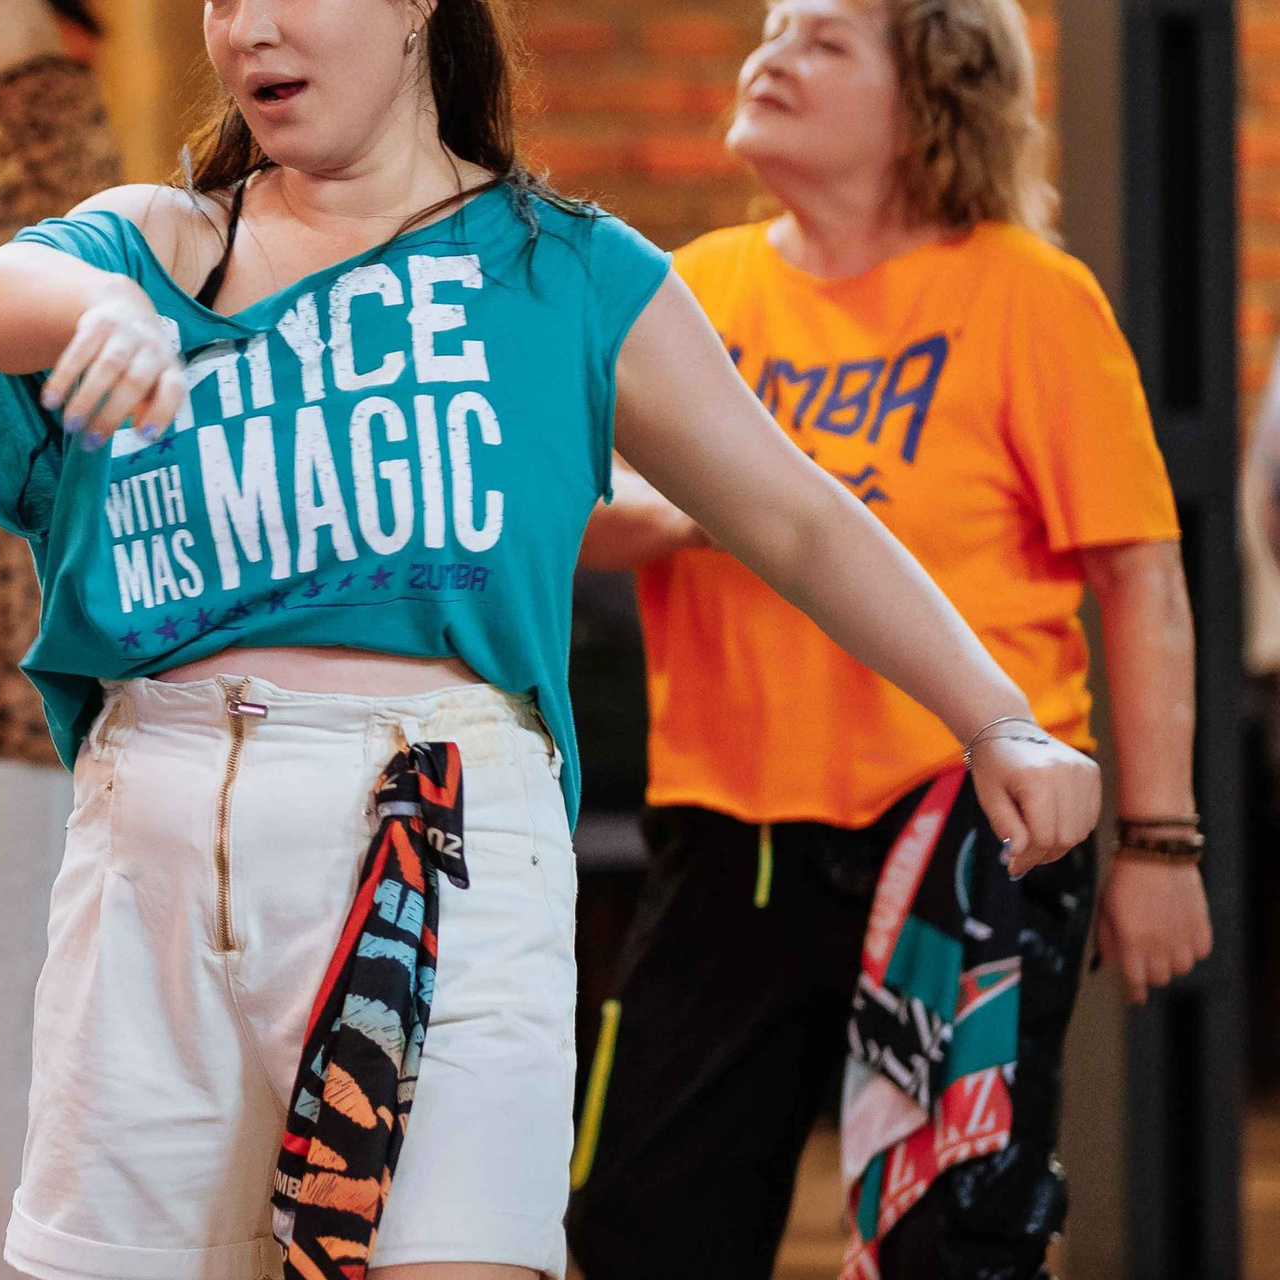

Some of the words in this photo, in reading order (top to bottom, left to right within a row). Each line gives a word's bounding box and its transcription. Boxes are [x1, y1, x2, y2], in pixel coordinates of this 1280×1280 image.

[104, 464, 187, 538] WITH
[197, 391, 504, 591] MAGIC
[113, 528, 205, 613] MAS
